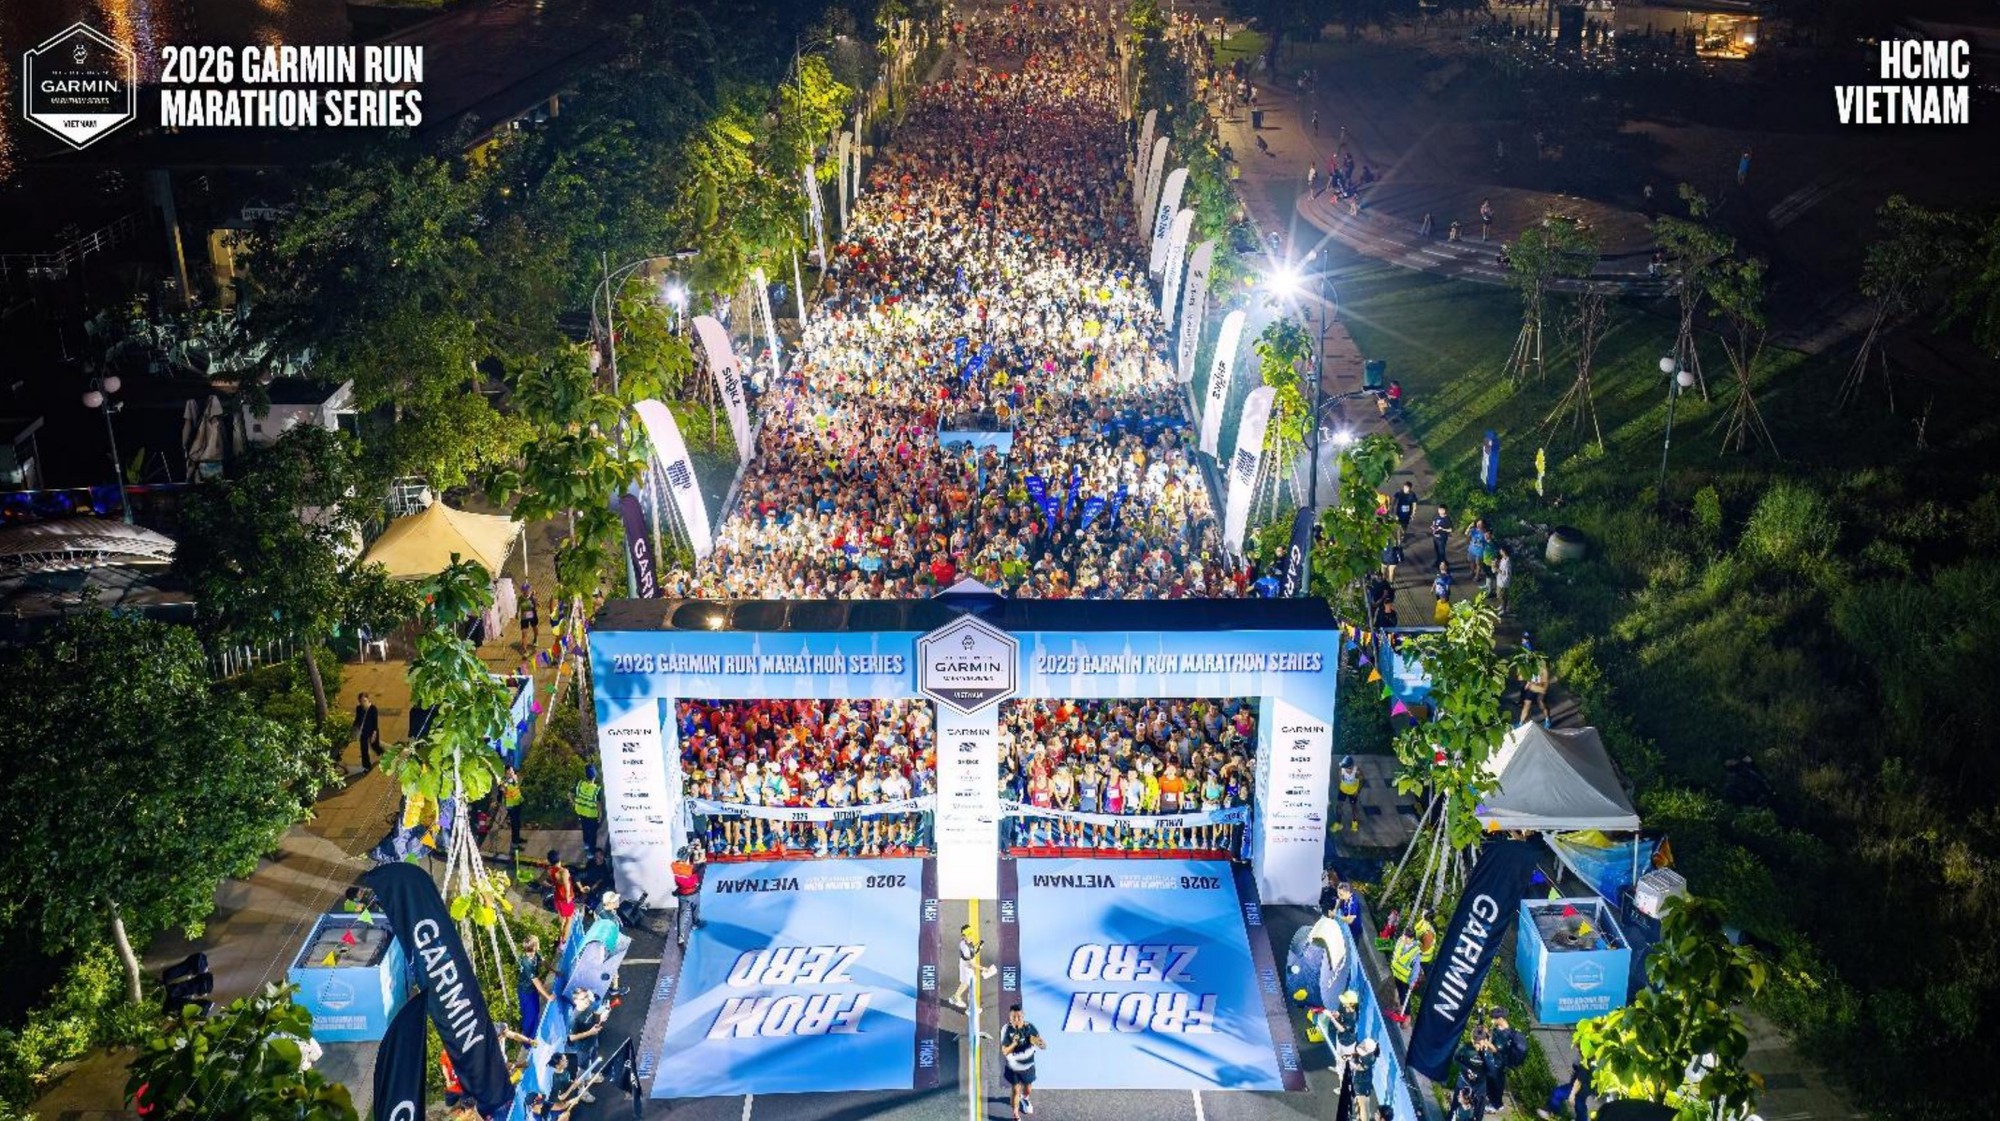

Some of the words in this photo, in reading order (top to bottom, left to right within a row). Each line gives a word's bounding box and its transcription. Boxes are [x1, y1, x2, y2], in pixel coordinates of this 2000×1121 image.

[721, 366, 741, 408] SHOKZ
[613, 653, 655, 674] 2026
[656, 653, 722, 674] GARMIN
[724, 654, 759, 674] RUN
[760, 653, 848, 674] MARATHON
[851, 653, 904, 674] SERIES
[935, 662, 1001, 672] GARMIN
[1037, 654, 1078, 675] 2026
[1080, 654, 1143, 674] GARMIN
[1146, 654, 1179, 674] RUN
[1181, 653, 1267, 673] MARATHON
[1269, 652, 1323, 673] SERIES
[608, 728, 652, 736] GARMIN
[946, 728, 990, 736] GARMIN
[715, 876, 799, 894] VIETNAM
[867, 874, 906, 889] 2026
[1033, 874, 1115, 889] VIETNAM
[1180, 875, 1221, 890] 2026
[925, 899, 938, 922] FINISH
[1002, 899, 1015, 923] FINISH
[726, 944, 867, 988] ZERO
[1067, 943, 1200, 983] ZERO
[1433, 893, 1499, 1022] GARMIN
[413, 918, 484, 1053] GARMIN
[922, 965, 936, 991] FINISH
[1003, 966, 1016, 992] FINISH
[704, 992, 873, 1040] FROM
[1062, 991, 1219, 1034] FROM
[920, 1039, 934, 1068] FINISH
[1280, 1043, 1298, 1071] FINISH
